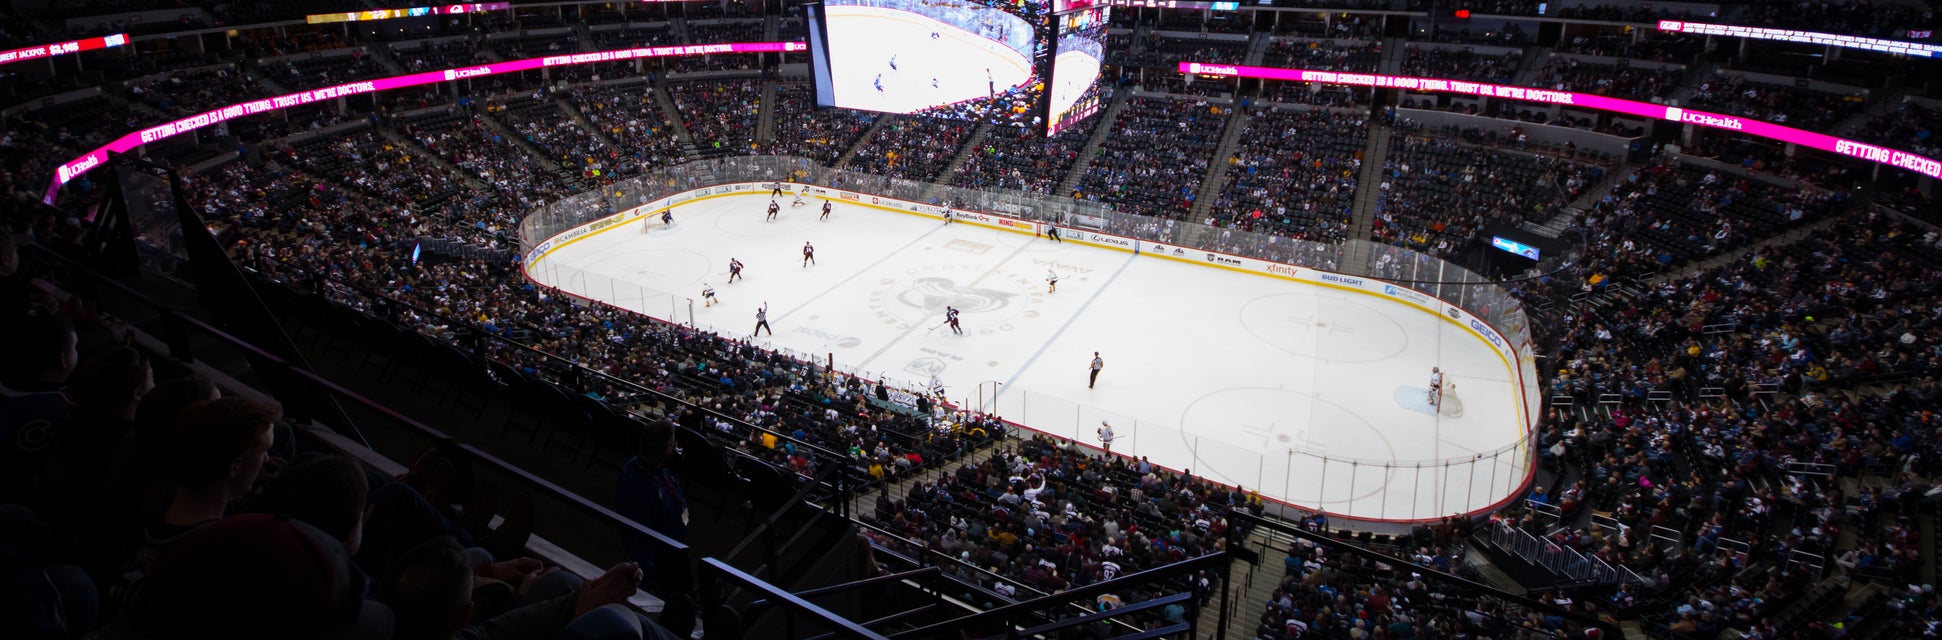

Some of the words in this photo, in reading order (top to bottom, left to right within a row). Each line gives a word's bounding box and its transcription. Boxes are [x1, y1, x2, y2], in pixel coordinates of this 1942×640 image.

[19, 48, 46, 58] JACKPOT:
[544, 56, 571, 66] GETTING
[572, 53, 600, 63] CHECKED
[601, 52, 608, 60] IS
[615, 50, 632, 58] GOOD
[632, 49, 652, 57] THING.
[653, 46, 673, 55] TRUST
[685, 46, 703, 54] WE'RE
[704, 44, 732, 52] DOCTORS.
[455, 66, 490, 78] UCHealth
[1200, 66, 1238, 75] UCHealth
[1302, 71, 1336, 82] GETTING
[1338, 74, 1375, 87] CHECKED
[1376, 76, 1385, 85] IS
[1386, 77, 1393, 86] A
[1394, 78, 1418, 88] GOOD
[1420, 79, 1449, 90] THING.
[1450, 82, 1479, 93] TRUST
[1480, 85, 1495, 95] US.
[1496, 86, 1525, 98] WE'RE
[1526, 90, 1574, 104] DOCTORS.
[140, 124, 175, 142] GETTING
[176, 114, 209, 132] CHECKED
[209, 112, 218, 123] IS
[218, 110, 224, 120] A
[224, 105, 242, 118] GOOD
[243, 100, 273, 113] THING.
[273, 94, 300, 108] TRUST
[300, 92, 314, 102] US.
[314, 88, 336, 100] WE'RE
[338, 81, 375, 96] DOCTORS.
[1682, 111, 1742, 130] UCHealth
[68, 154, 98, 177] UCHealth
[1836, 140, 1890, 163] GETTING
[1891, 152, 1941, 177] CHECKED
[957, 212, 978, 220] KeyBank
[999, 218, 1014, 227] KING
[560, 228, 587, 242] CAMBRIA
[1100, 238, 1128, 246] LEXUS
[530, 242, 550, 261] GEICO
[1266, 264, 1298, 276] xfinity
[1340, 277, 1363, 286] LIGHT
[1471, 319, 1502, 347] GEICO
